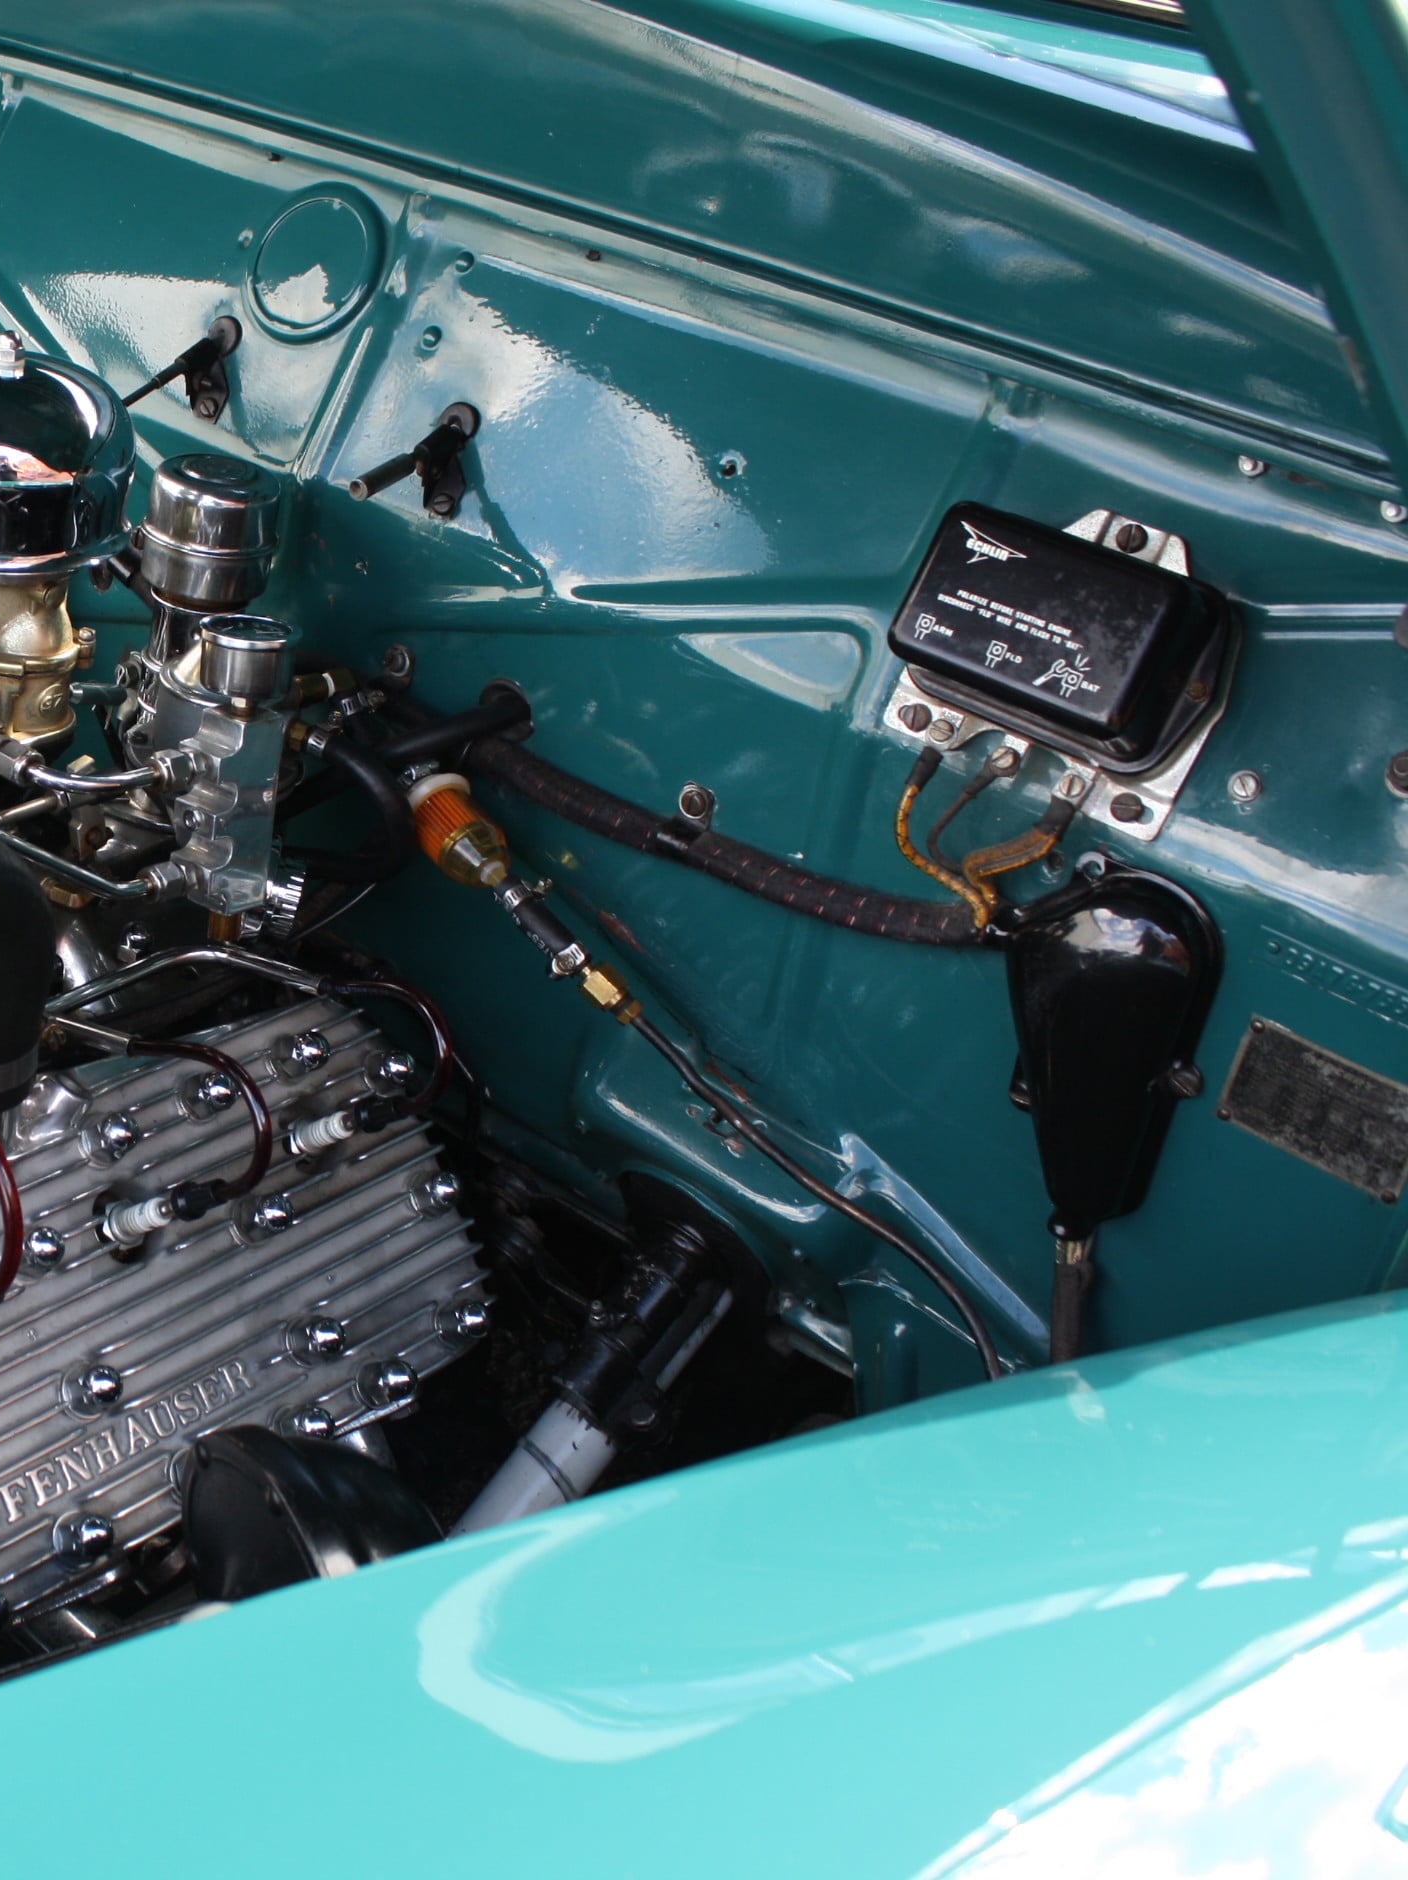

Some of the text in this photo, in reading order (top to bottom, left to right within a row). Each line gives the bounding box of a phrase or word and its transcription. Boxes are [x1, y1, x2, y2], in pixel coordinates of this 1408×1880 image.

[965, 537, 1009, 561] ECHLIN
[933, 624, 954, 638] ARM
[1005, 652, 1023, 664] FLD
[1080, 679, 1101, 694] BAT
